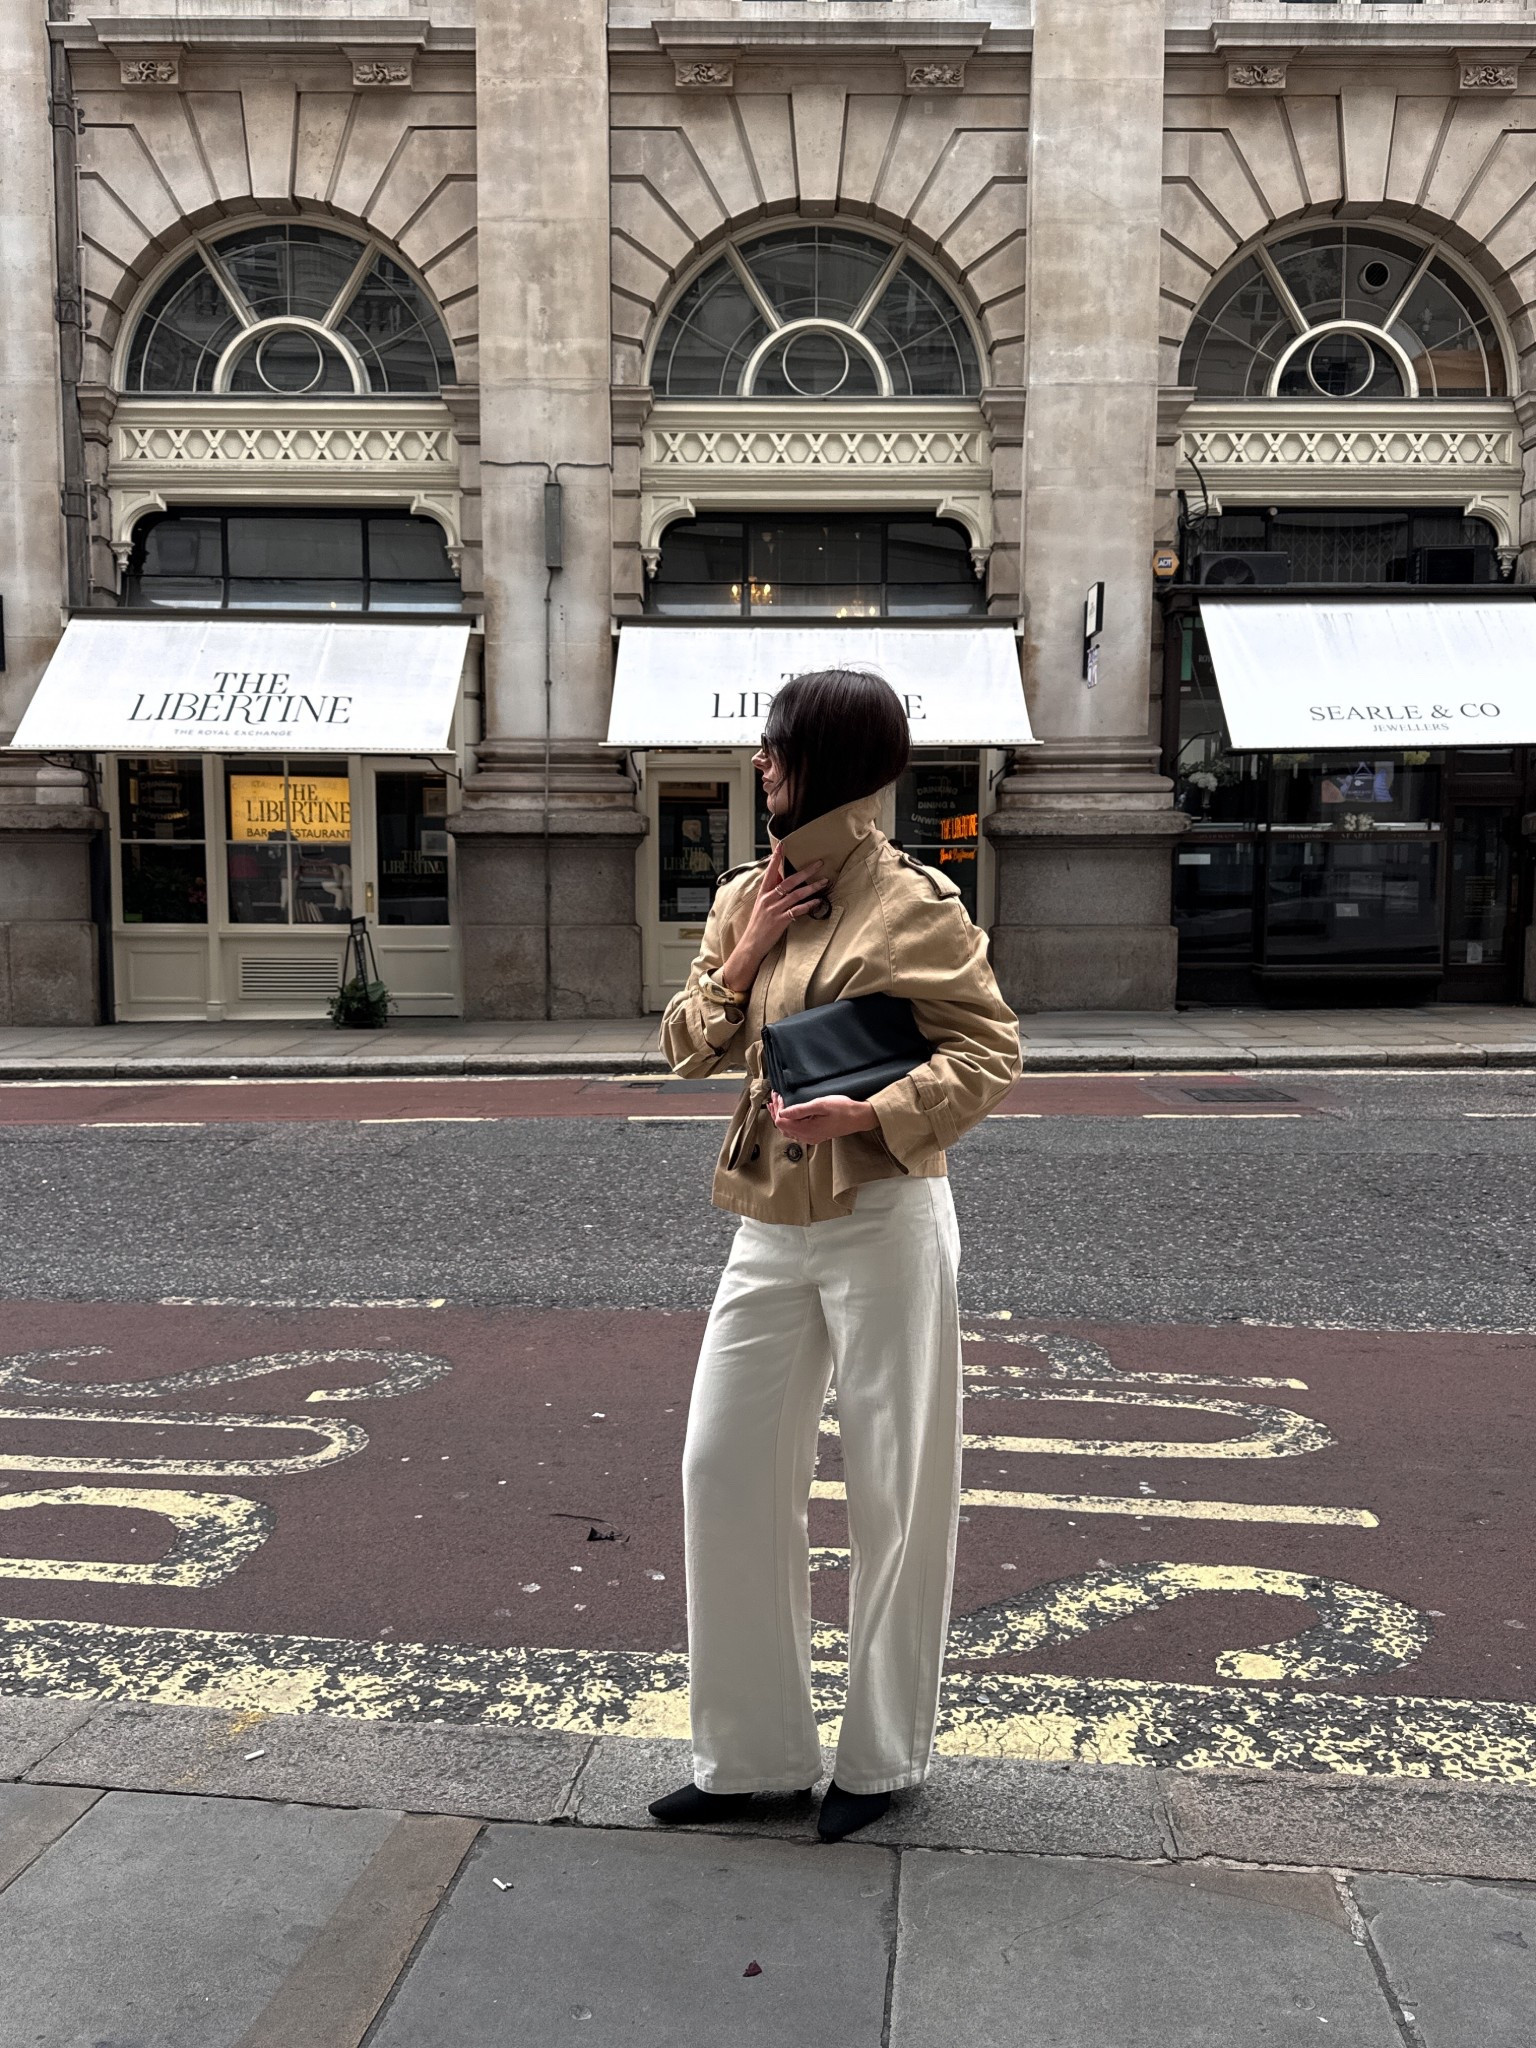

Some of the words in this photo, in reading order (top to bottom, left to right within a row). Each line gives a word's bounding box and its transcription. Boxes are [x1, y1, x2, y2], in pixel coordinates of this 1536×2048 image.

[1158, 558, 1172, 567] ADT
[213, 672, 290, 694] THE
[128, 692, 353, 725] LIBERTINE
[1309, 704, 1423, 722] SEARLE
[1430, 704, 1454, 719] &
[1460, 702, 1501, 718] CO
[174, 728, 194, 736] THE
[197, 728, 230, 736] ROYAL
[234, 729, 292, 737] EXCHANGE
[1372, 722, 1450, 733] JEWELLERS
[279, 783, 318, 801] THE
[917, 800, 948, 809] DINING
[246, 799, 351, 825] LIBERTINE
[246, 828, 268, 837] BAR
[282, 828, 351, 838] STAURANT
